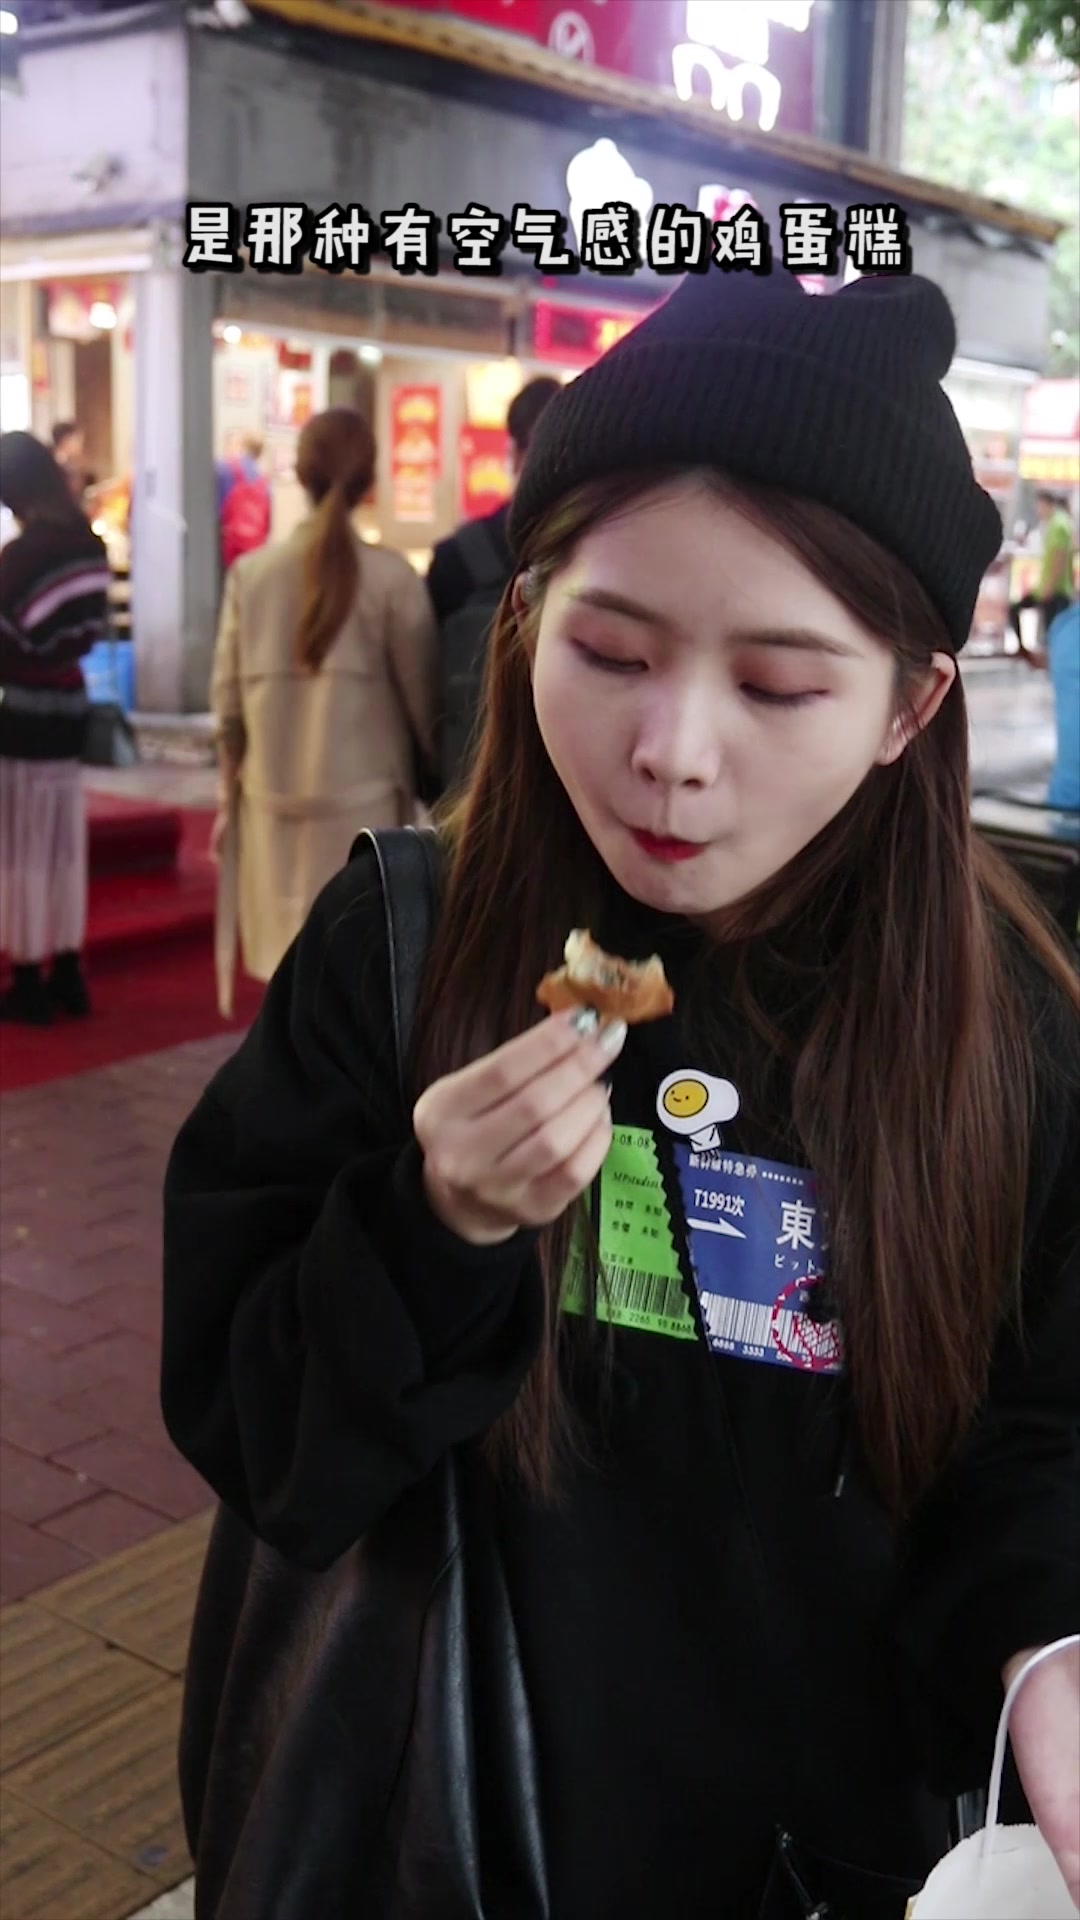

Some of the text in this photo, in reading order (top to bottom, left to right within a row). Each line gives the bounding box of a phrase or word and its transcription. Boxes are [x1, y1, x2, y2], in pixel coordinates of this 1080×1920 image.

[611, 1131, 651, 1149] -08-08
[694, 1188, 746, 1218] T1991次
[775, 1199, 828, 1251] 東
